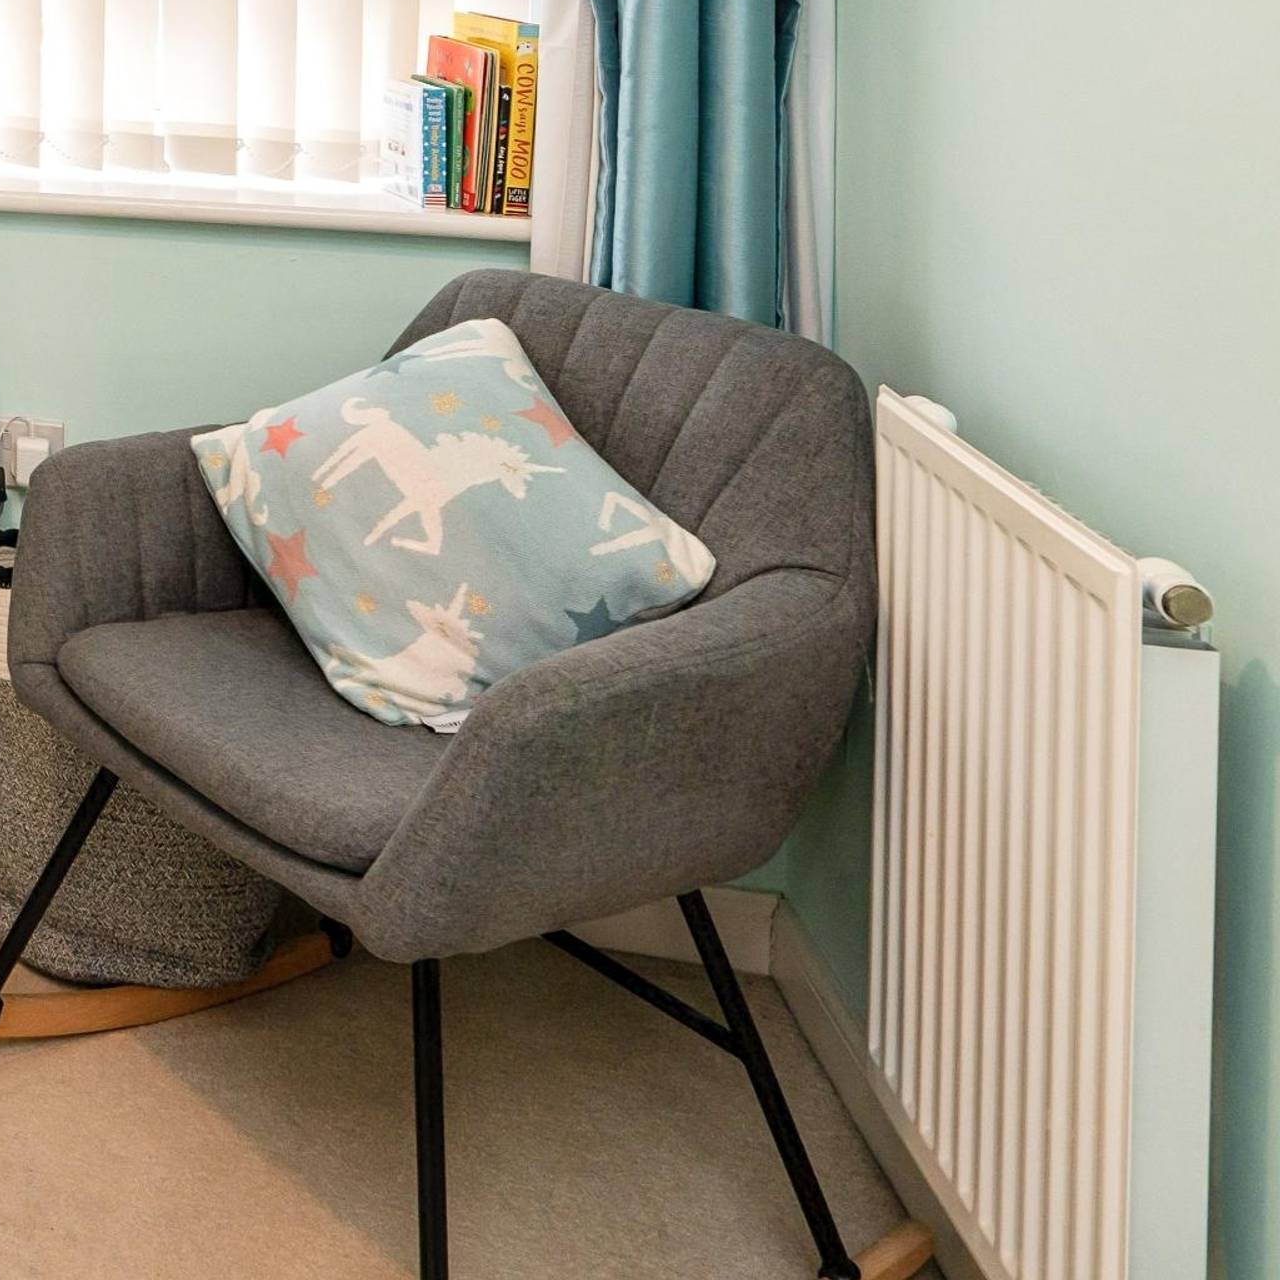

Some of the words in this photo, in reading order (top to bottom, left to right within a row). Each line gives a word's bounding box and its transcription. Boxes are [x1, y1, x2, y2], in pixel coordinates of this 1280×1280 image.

[515, 62, 535, 106] COW
[514, 107, 528, 134] says
[510, 138, 531, 180] MOO
